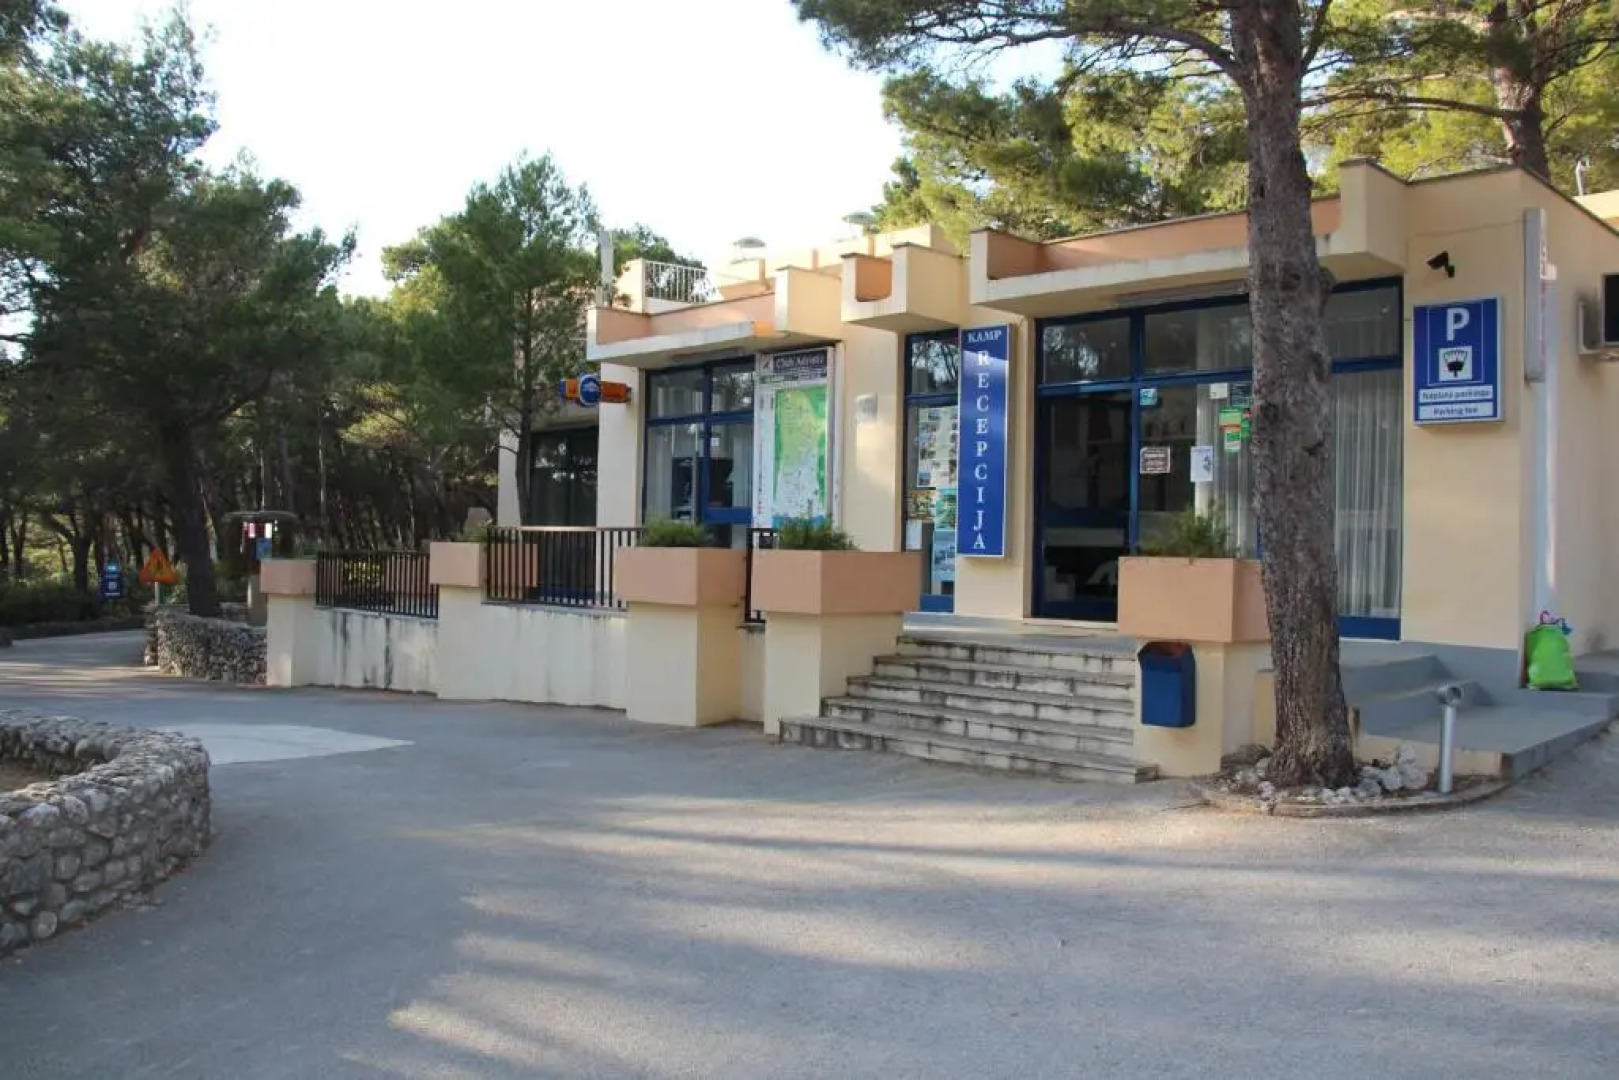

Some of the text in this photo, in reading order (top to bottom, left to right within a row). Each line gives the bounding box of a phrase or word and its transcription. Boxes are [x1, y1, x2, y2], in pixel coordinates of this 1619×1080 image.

[968, 330, 1002, 342] KAMP
[1446, 307, 1469, 341] P
[973, 350, 989, 549] RECEPCIJA
